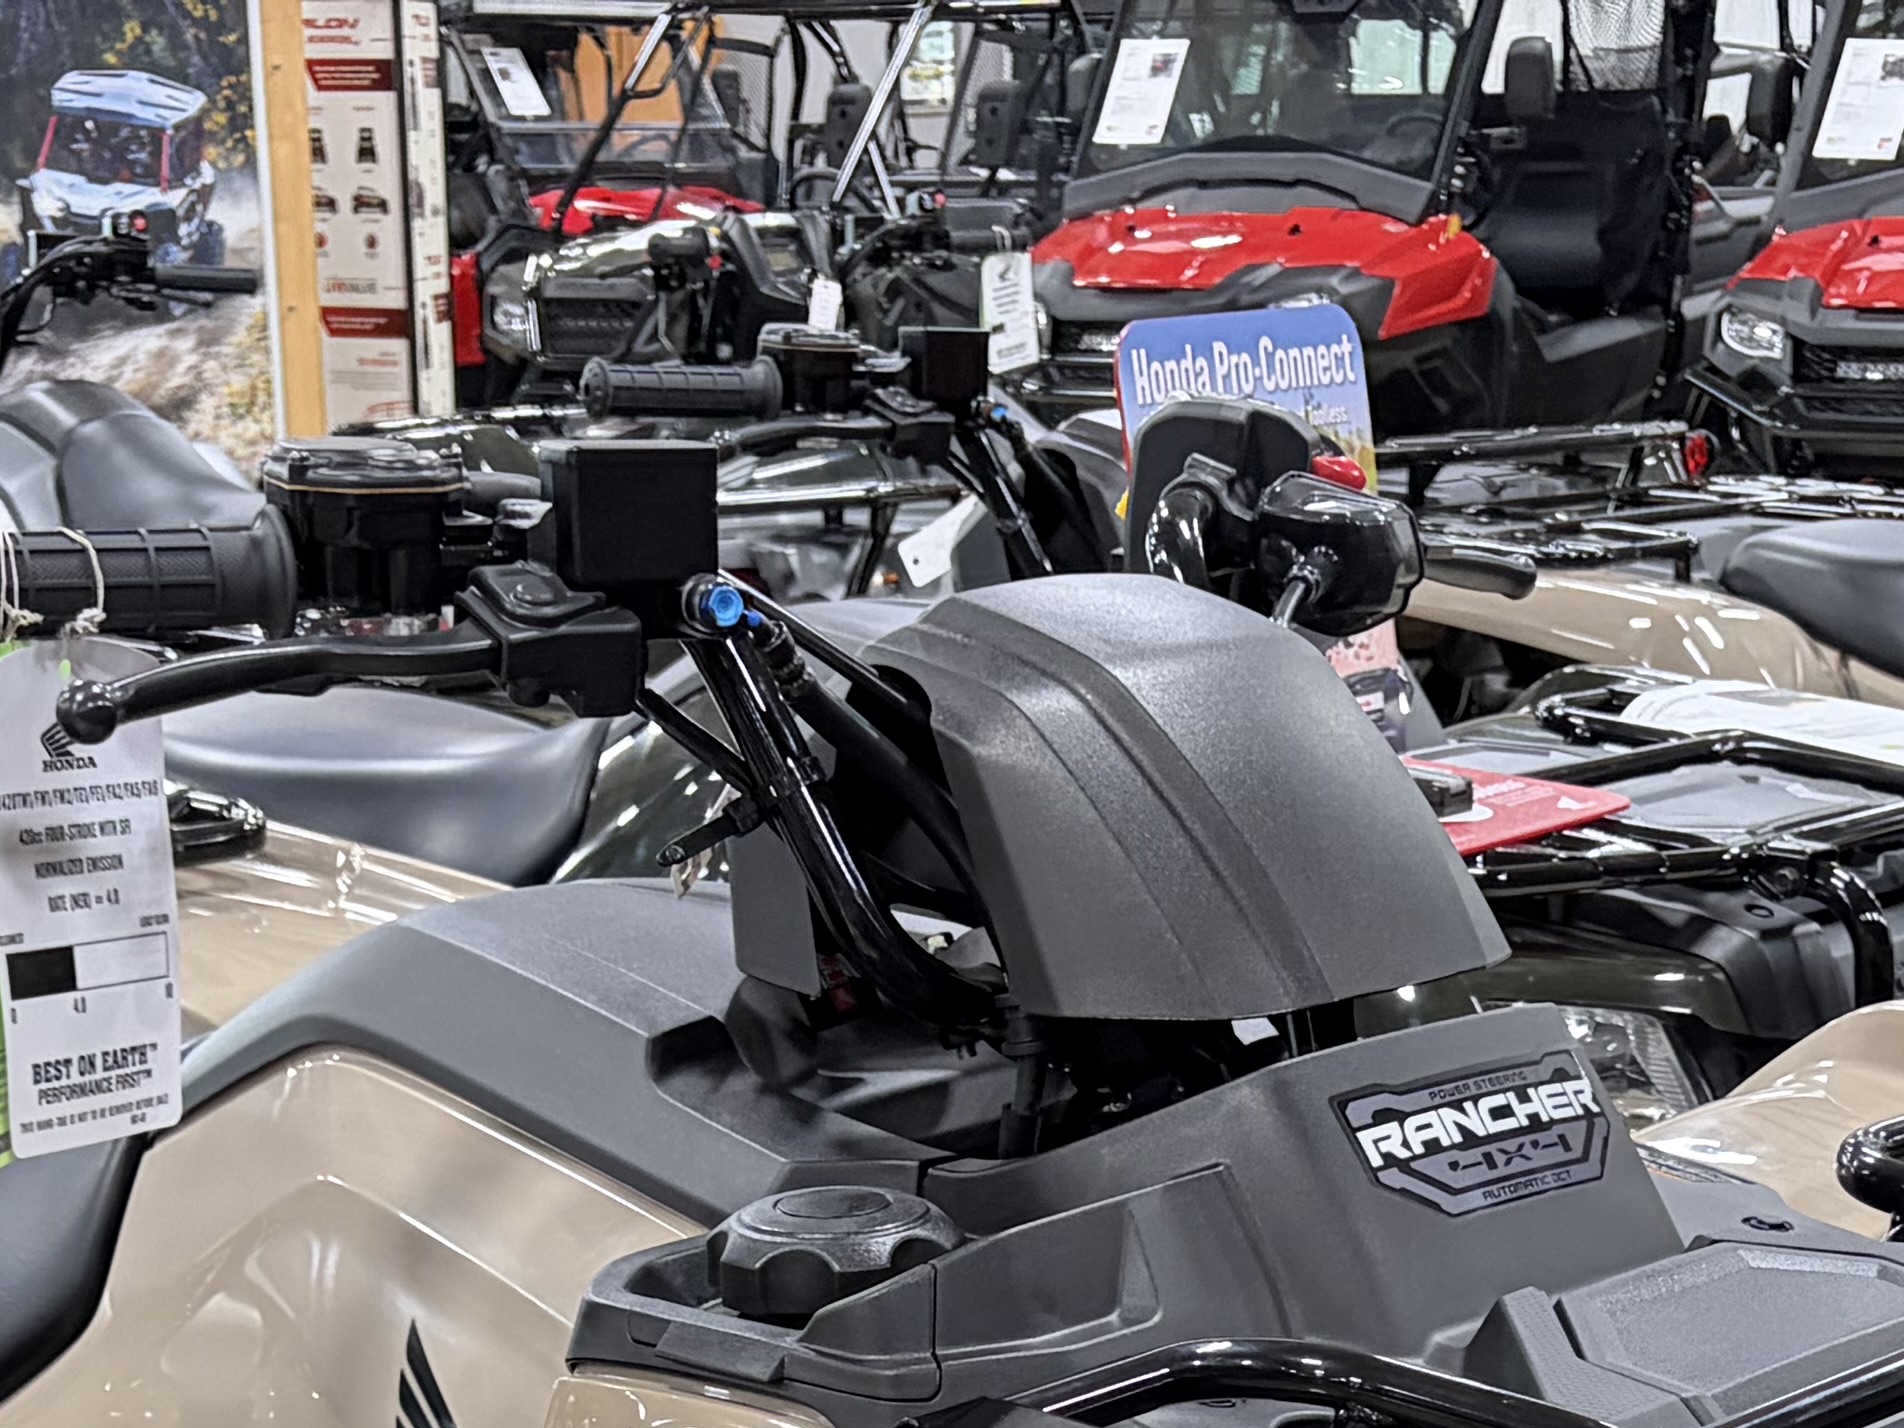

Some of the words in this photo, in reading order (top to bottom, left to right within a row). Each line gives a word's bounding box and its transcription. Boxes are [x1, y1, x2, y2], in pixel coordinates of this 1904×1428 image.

[1131, 343, 1211, 406] Honda
[1212, 333, 1356, 395] Pro-Connect
[42, 756, 98, 773] HONDA
[86, 853, 124, 874] EMISSION
[31, 1055, 73, 1086] BEST
[77, 1052, 97, 1078] ON
[37, 1075, 113, 1107] PERFORMANCE
[1429, 1081, 1472, 1101] POWER
[1475, 1070, 1529, 1092] STEERING
[1356, 1077, 1601, 1168] RANCHER
[1482, 1174, 1549, 1202] AUTOMATIC
[1551, 1169, 1572, 1185] DCT
